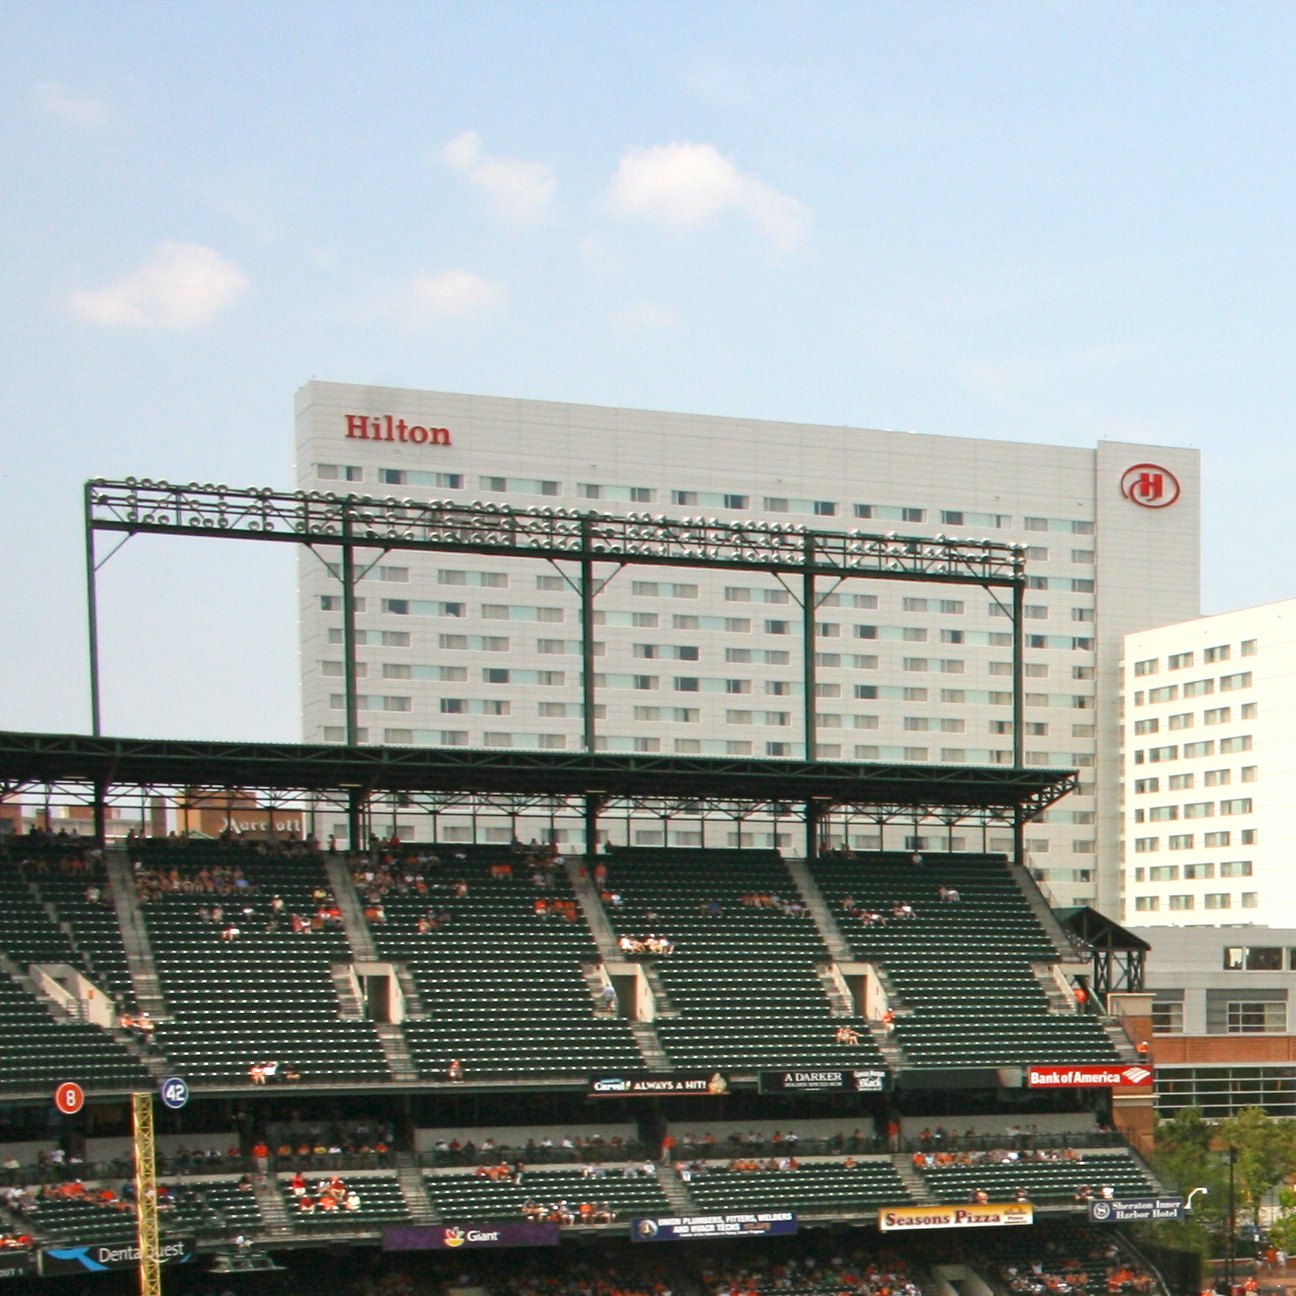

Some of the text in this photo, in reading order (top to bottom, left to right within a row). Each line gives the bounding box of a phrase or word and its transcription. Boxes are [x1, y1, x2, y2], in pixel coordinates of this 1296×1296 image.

[344, 414, 452, 446] Hilton
[218, 817, 301, 834] Marrott
[785, 1073, 793, 1082] A
[795, 1072, 843, 1082] DARKER
[1030, 1070, 1121, 1085] Bank of America
[634, 1079, 673, 1091] ALWAYS
[66, 1089, 76, 1107] 8
[166, 1084, 186, 1102] 42
[1112, 1201, 1153, 1211] Sheraton
[1156, 1200, 1181, 1209] Inner
[885, 1212, 950, 1227] Seasons
[954, 1209, 1001, 1225] Pizza
[1116, 1208, 1177, 1219] Harbor Hotel
[467, 1229, 500, 1242] Giant
